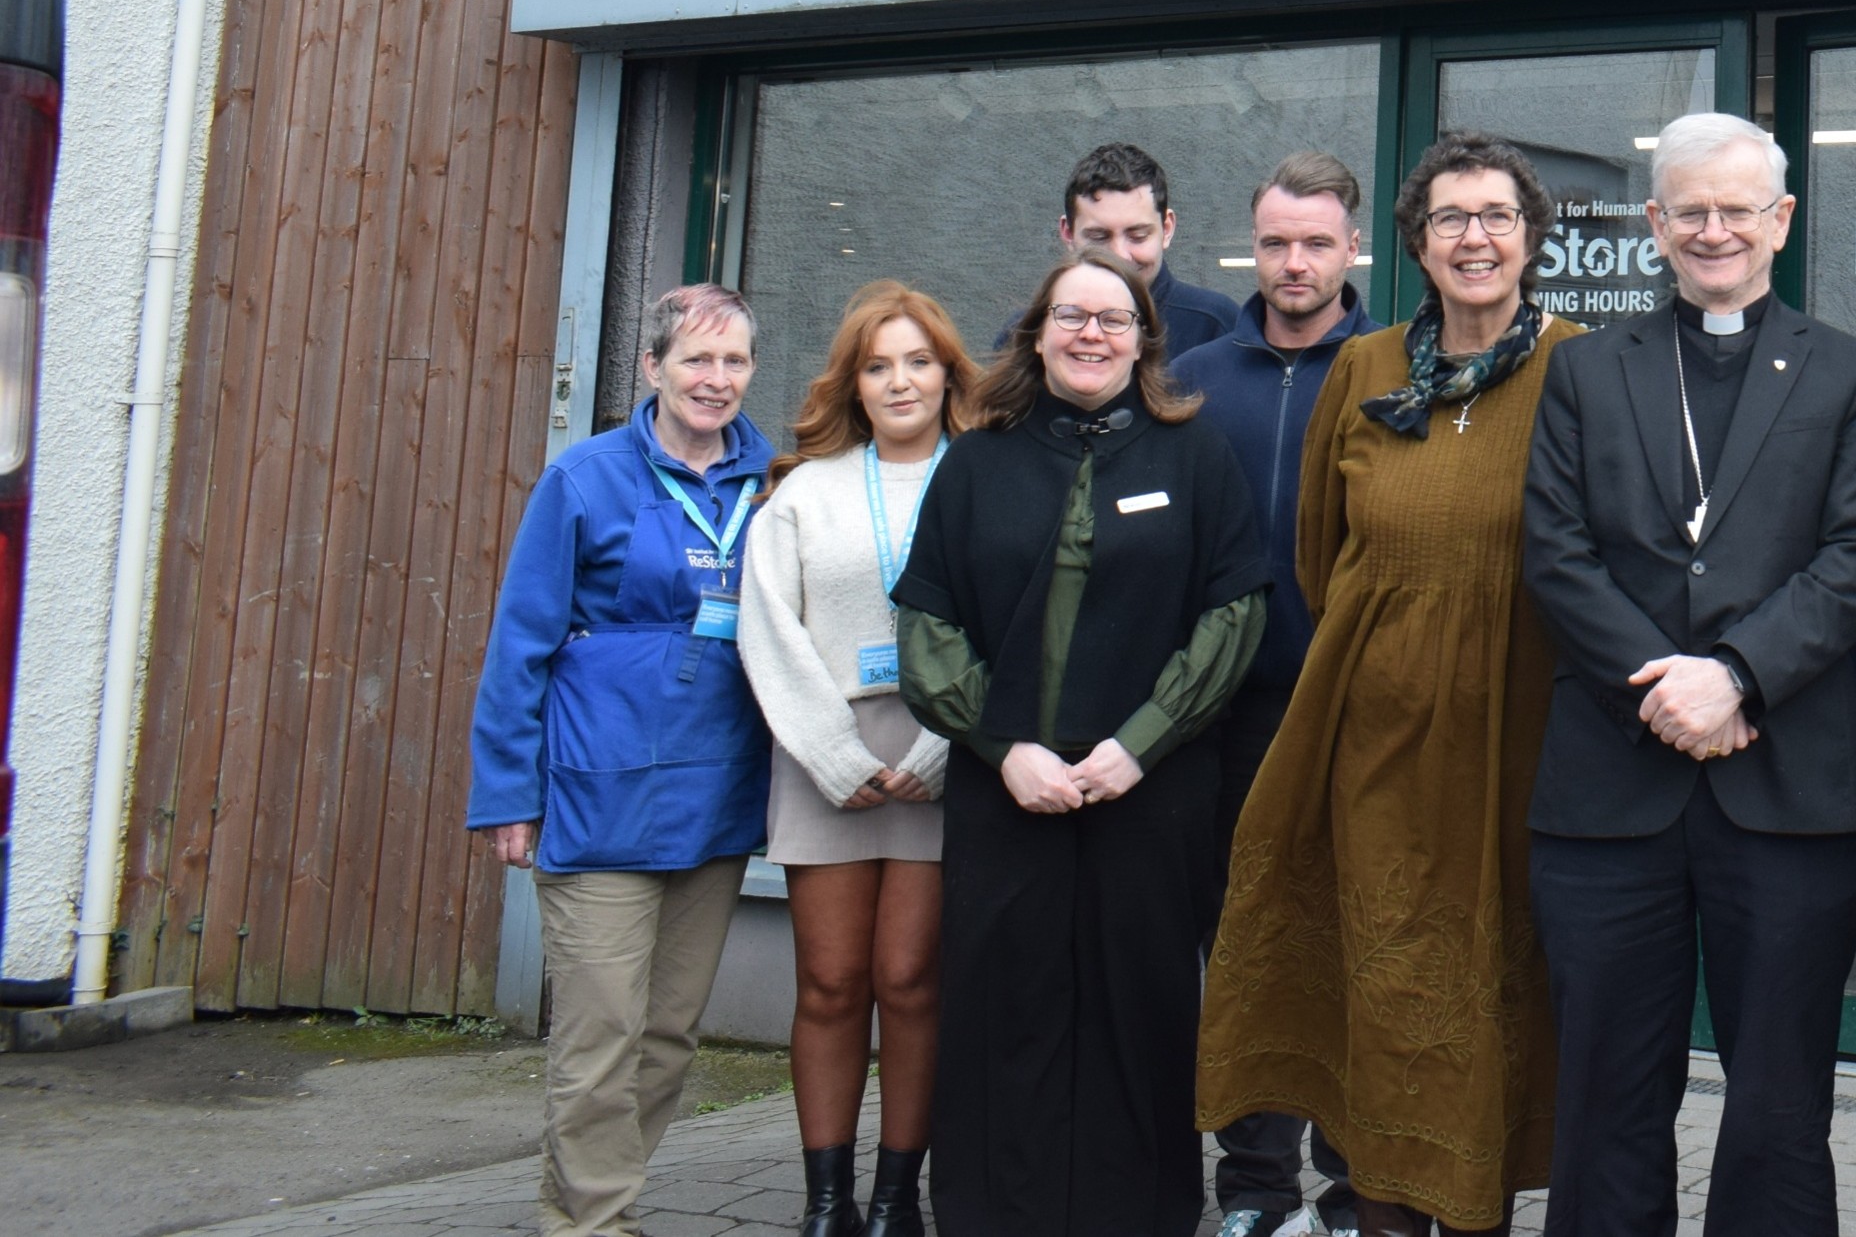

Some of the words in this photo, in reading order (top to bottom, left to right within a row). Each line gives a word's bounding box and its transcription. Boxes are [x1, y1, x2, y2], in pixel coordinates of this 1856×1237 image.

[1567, 201, 1589, 218] for
[1584, 290, 1655, 313] HOURS
[877, 531, 889, 554] place
